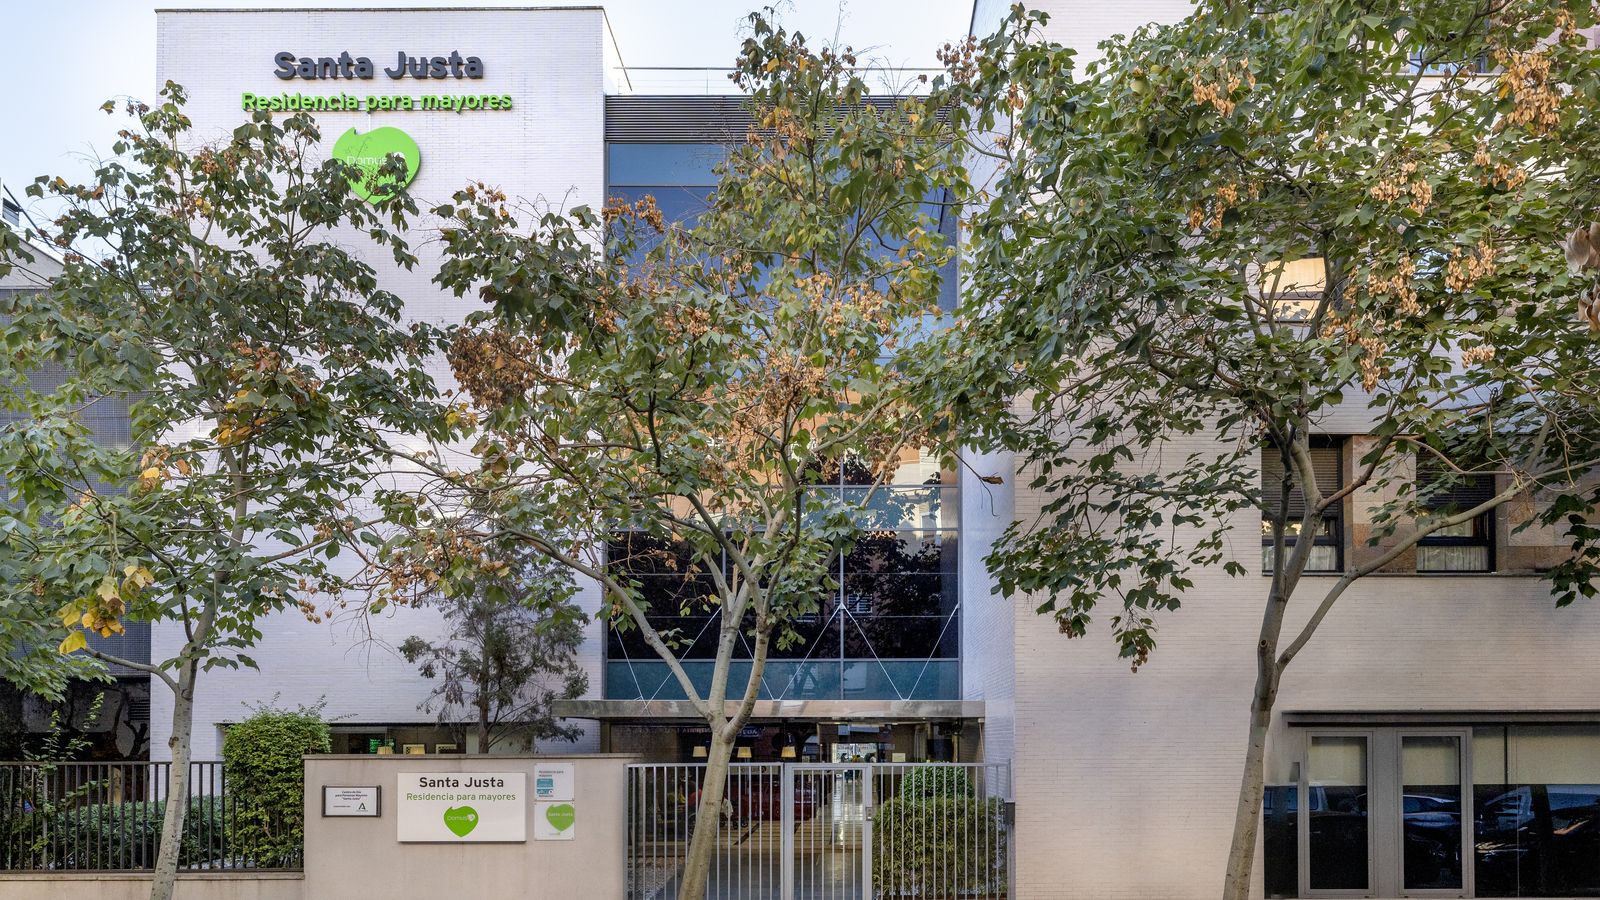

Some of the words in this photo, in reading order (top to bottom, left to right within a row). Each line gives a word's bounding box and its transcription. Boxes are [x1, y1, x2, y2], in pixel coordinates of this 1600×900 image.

[274, 50, 373, 80] Santa
[384, 50, 484, 80] Justa
[241, 92, 359, 112] Residencia
[365, 96, 413, 114] para
[420, 94, 512, 115] mayores
[419, 777, 459, 788] Santa
[464, 777, 504, 788] Justa
[406, 793, 454, 801] Residencia
[456, 794, 476, 802] para
[478, 794, 516, 802] mayores
